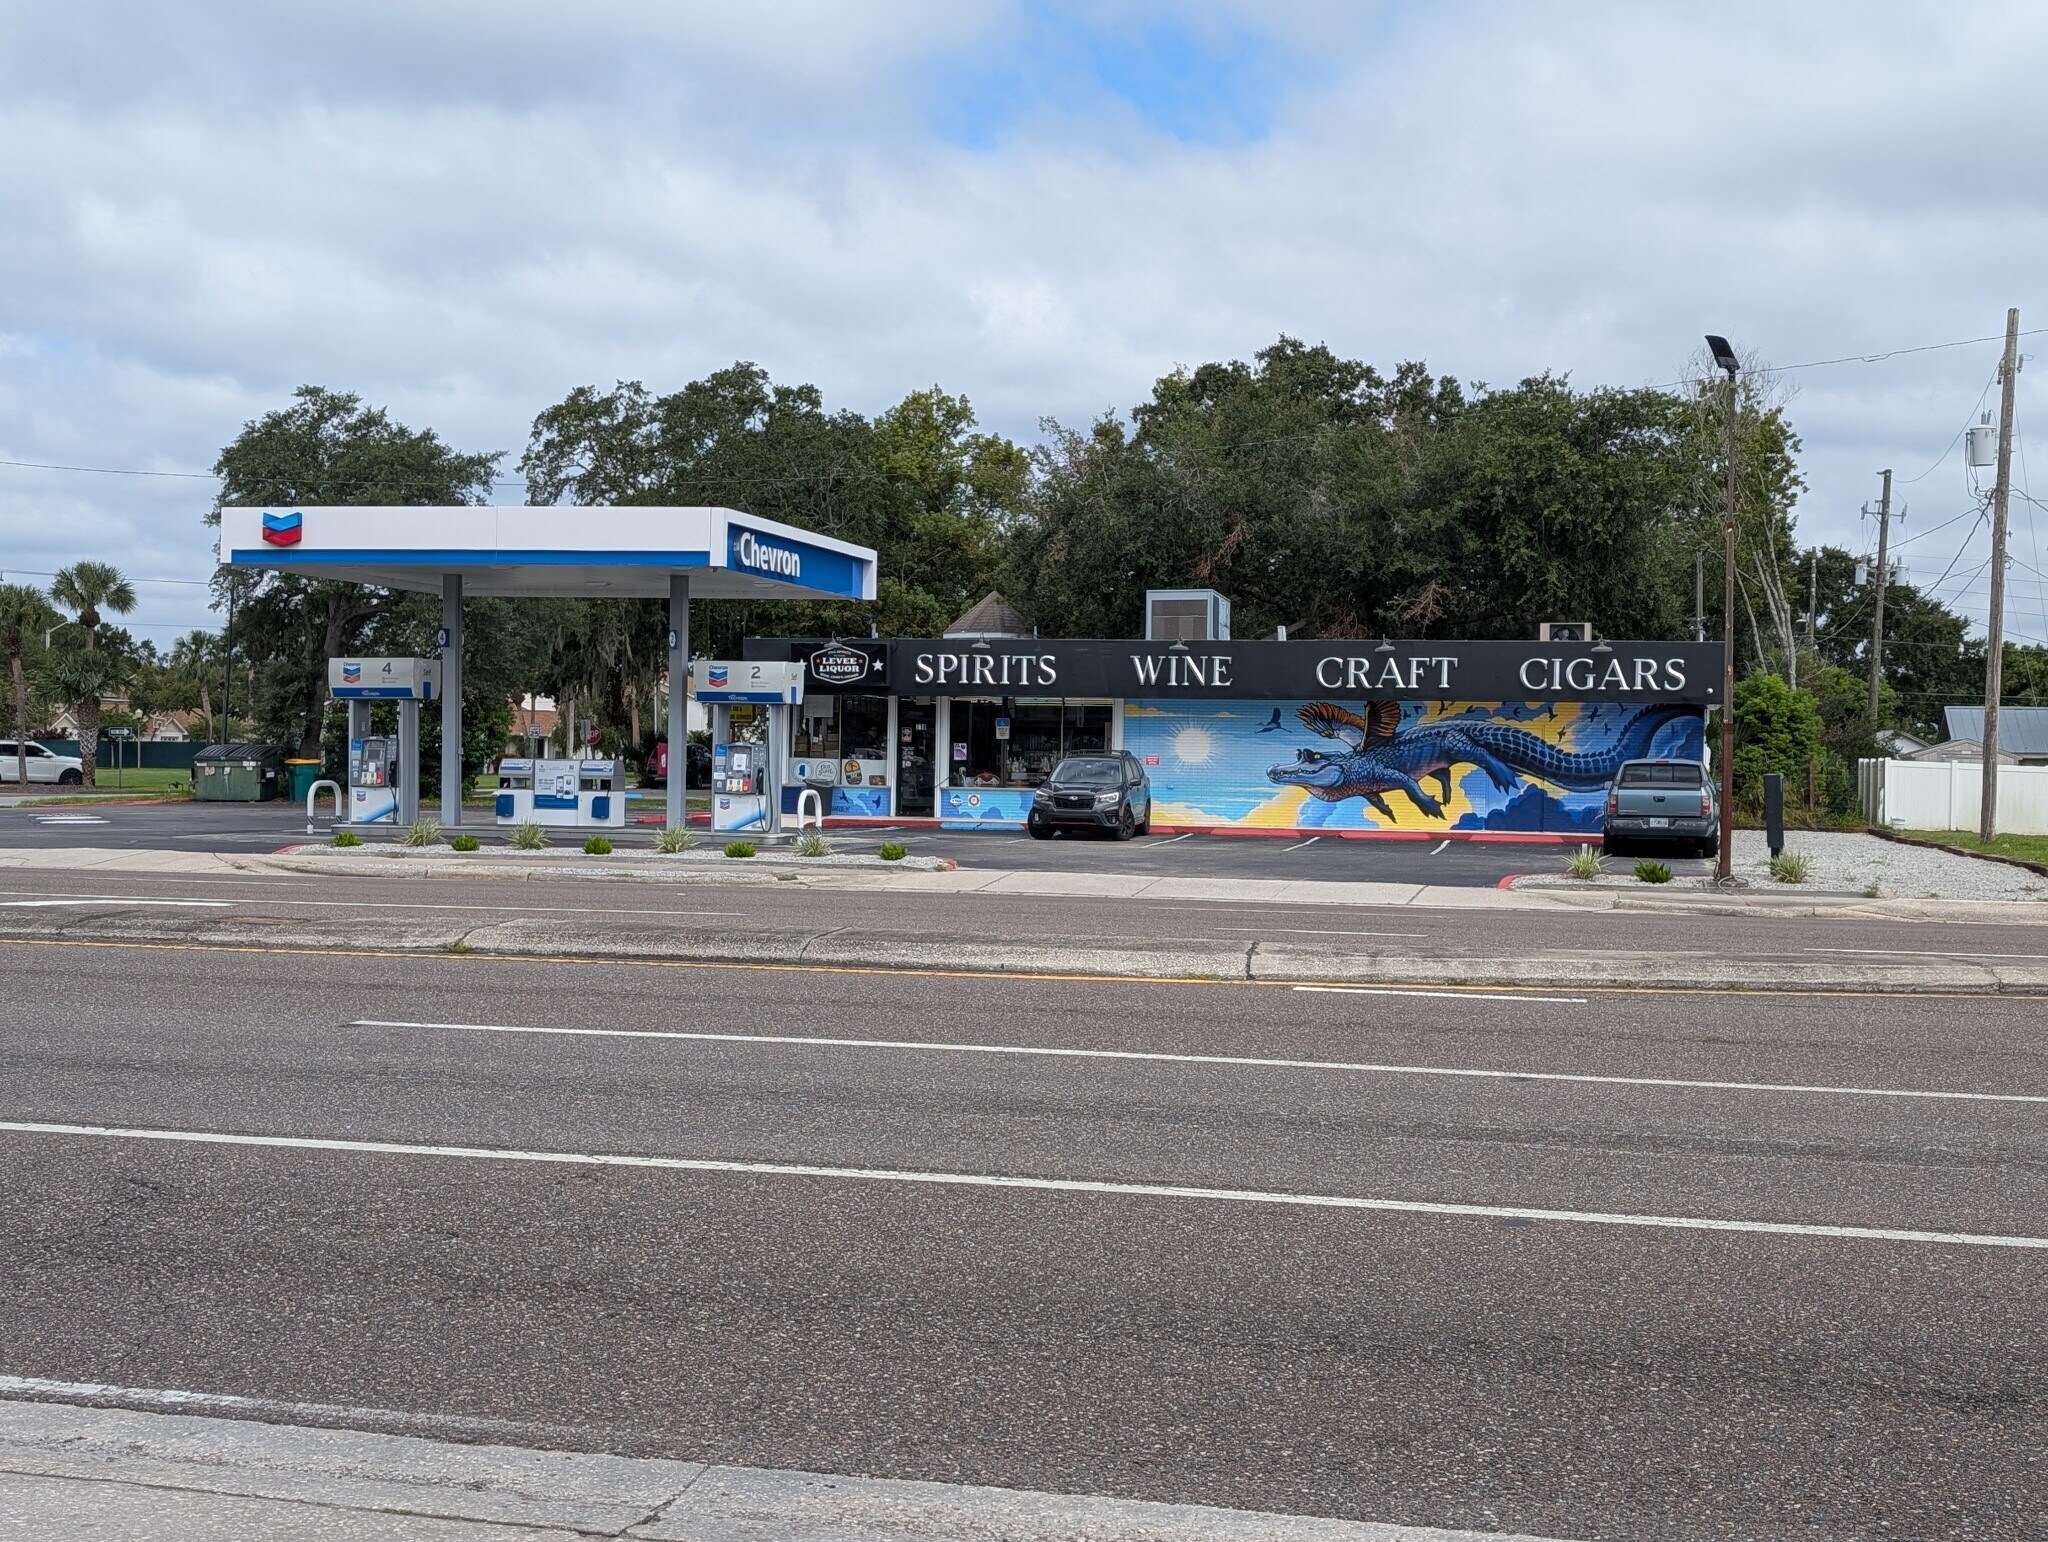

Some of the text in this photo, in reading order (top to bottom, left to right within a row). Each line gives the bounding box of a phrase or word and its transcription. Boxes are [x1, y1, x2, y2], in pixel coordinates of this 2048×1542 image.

[740, 532, 800, 577] Chevron
[382, 662, 392, 674] 4
[751, 666, 760, 679] 2
[820, 665, 859, 673] LIQUOR
[915, 654, 1686, 690] SPIRITS WINE CRAFT CIGARS
